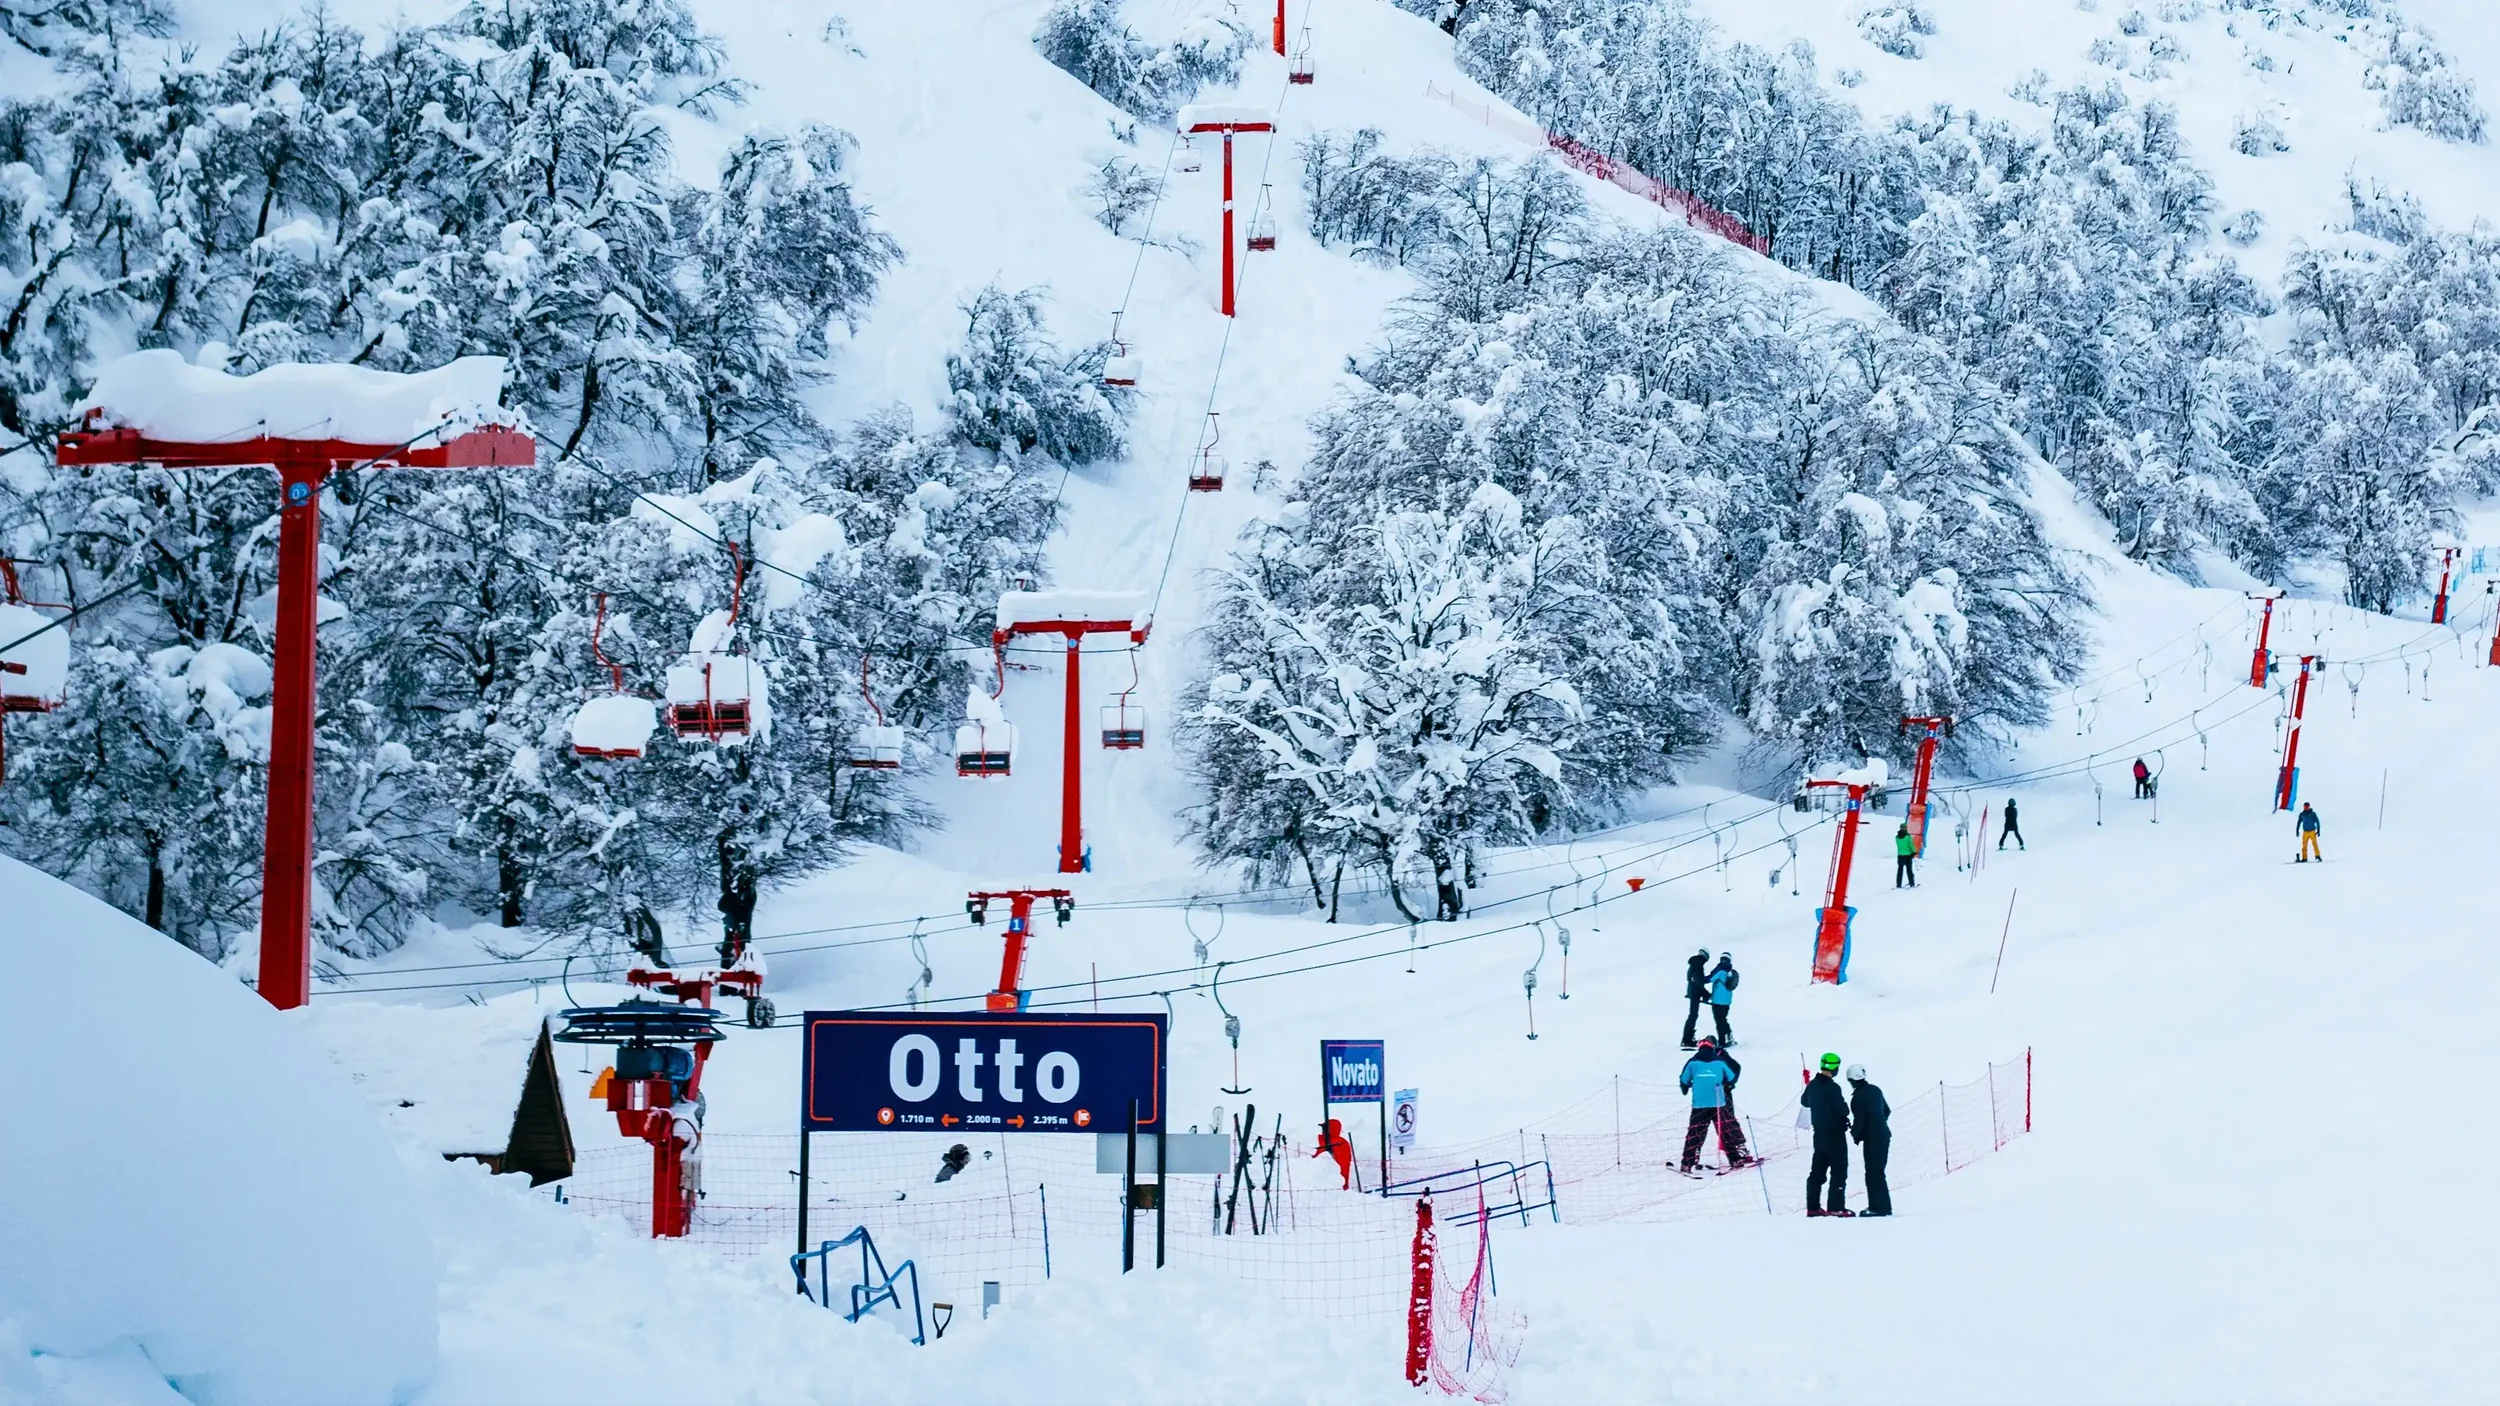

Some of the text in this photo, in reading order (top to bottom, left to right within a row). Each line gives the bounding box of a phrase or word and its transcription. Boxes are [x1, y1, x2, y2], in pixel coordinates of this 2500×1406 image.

[1929, 729, 1935, 737] 2
[1850, 800, 1857, 810] 1
[1013, 918, 1021, 931] 1
[889, 1033, 1081, 1104] Otto
[1331, 1056, 1379, 1087] Novato
[900, 1114, 935, 1124] 1.710 m
[966, 1114, 1001, 1124] 2.000 m
[1033, 1115, 1068, 1125] 2.395 m
